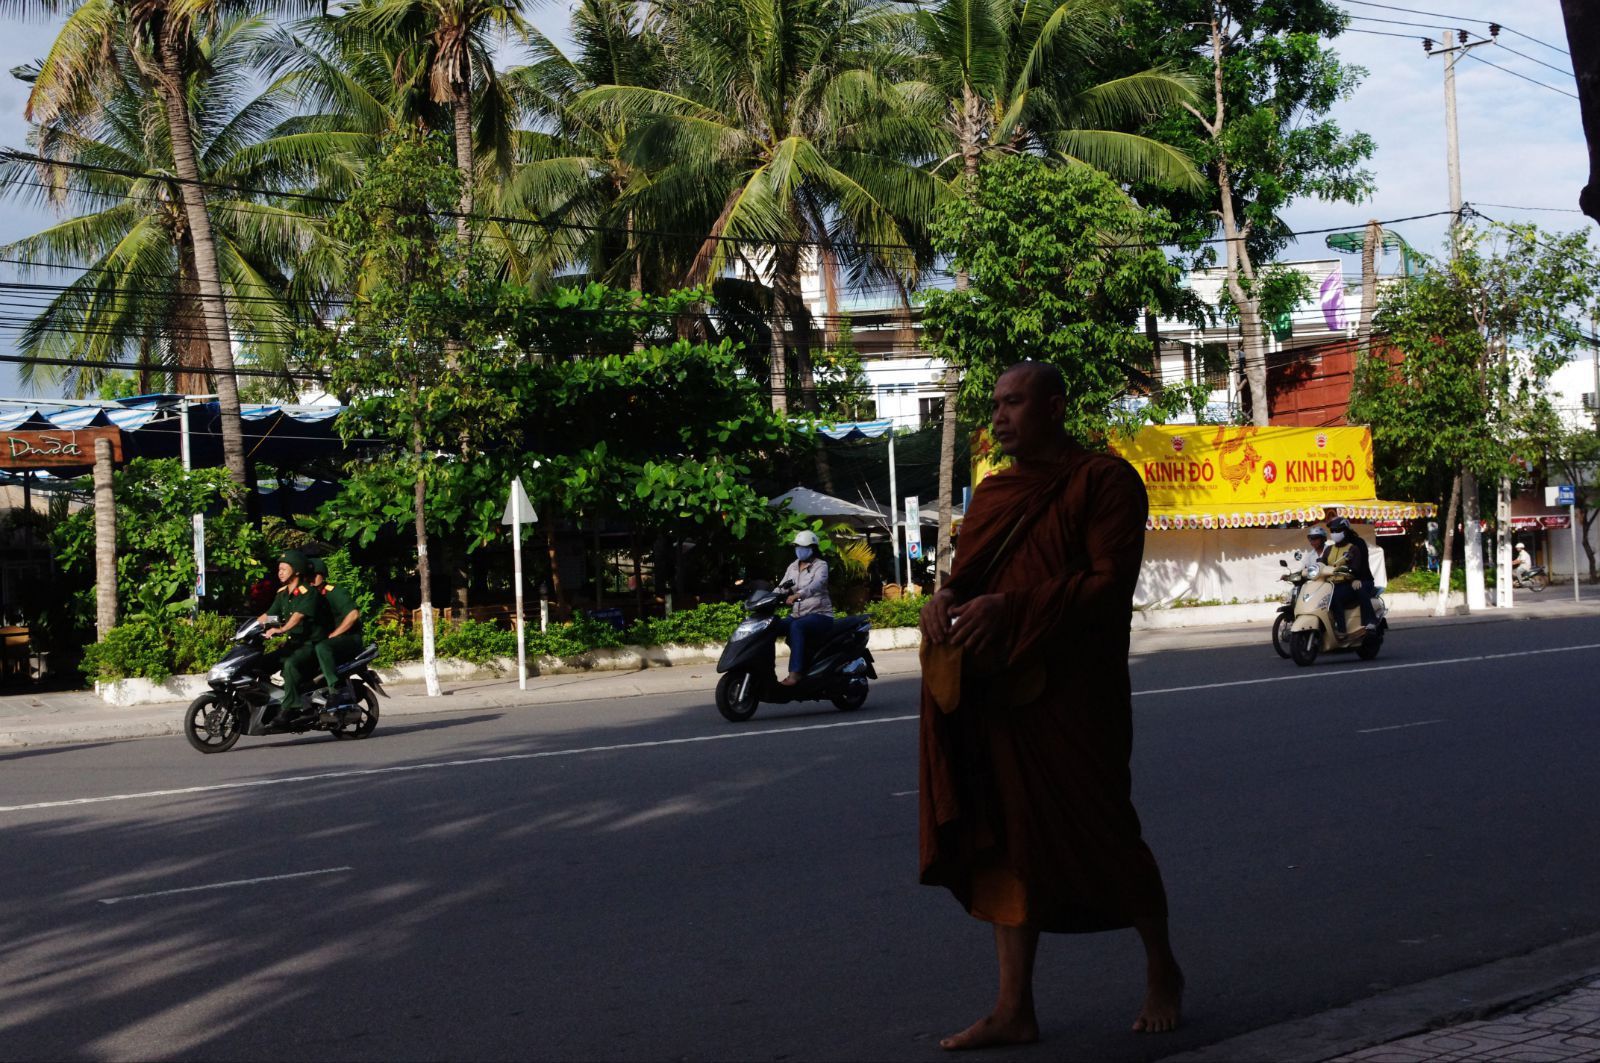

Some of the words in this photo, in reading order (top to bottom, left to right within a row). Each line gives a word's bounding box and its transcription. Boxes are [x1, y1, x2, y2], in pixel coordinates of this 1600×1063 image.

[1144, 461, 1185, 482] KINH
[1286, 460, 1328, 483] KINH
[1331, 455, 1355, 482] ĐÔ
